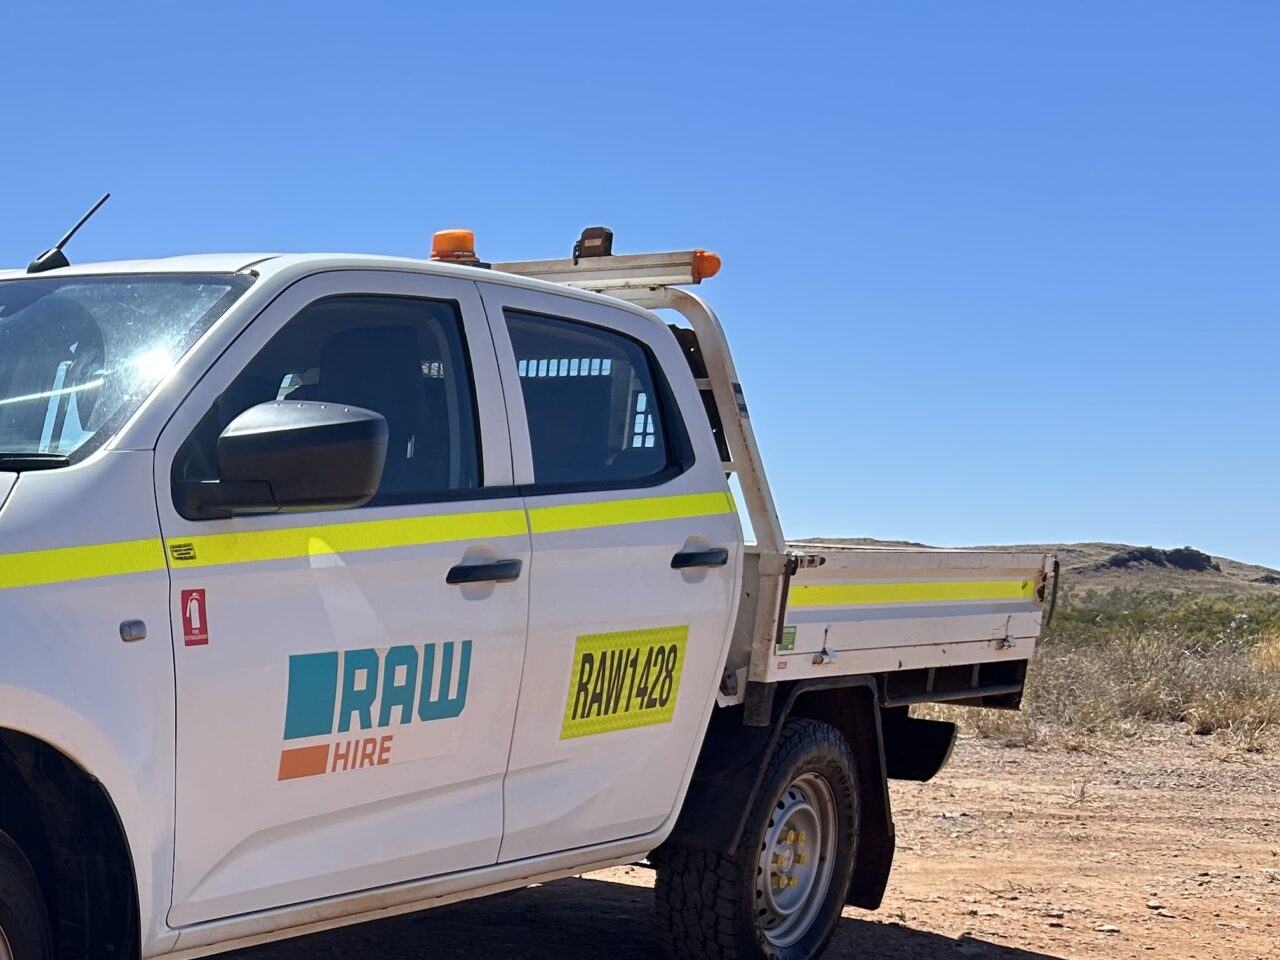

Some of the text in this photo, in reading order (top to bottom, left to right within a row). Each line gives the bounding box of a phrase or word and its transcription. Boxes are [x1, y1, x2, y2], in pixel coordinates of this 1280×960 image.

[337, 639, 473, 734] RAW
[571, 644, 678, 721] RAW1428
[331, 735, 394, 773] HIRE
